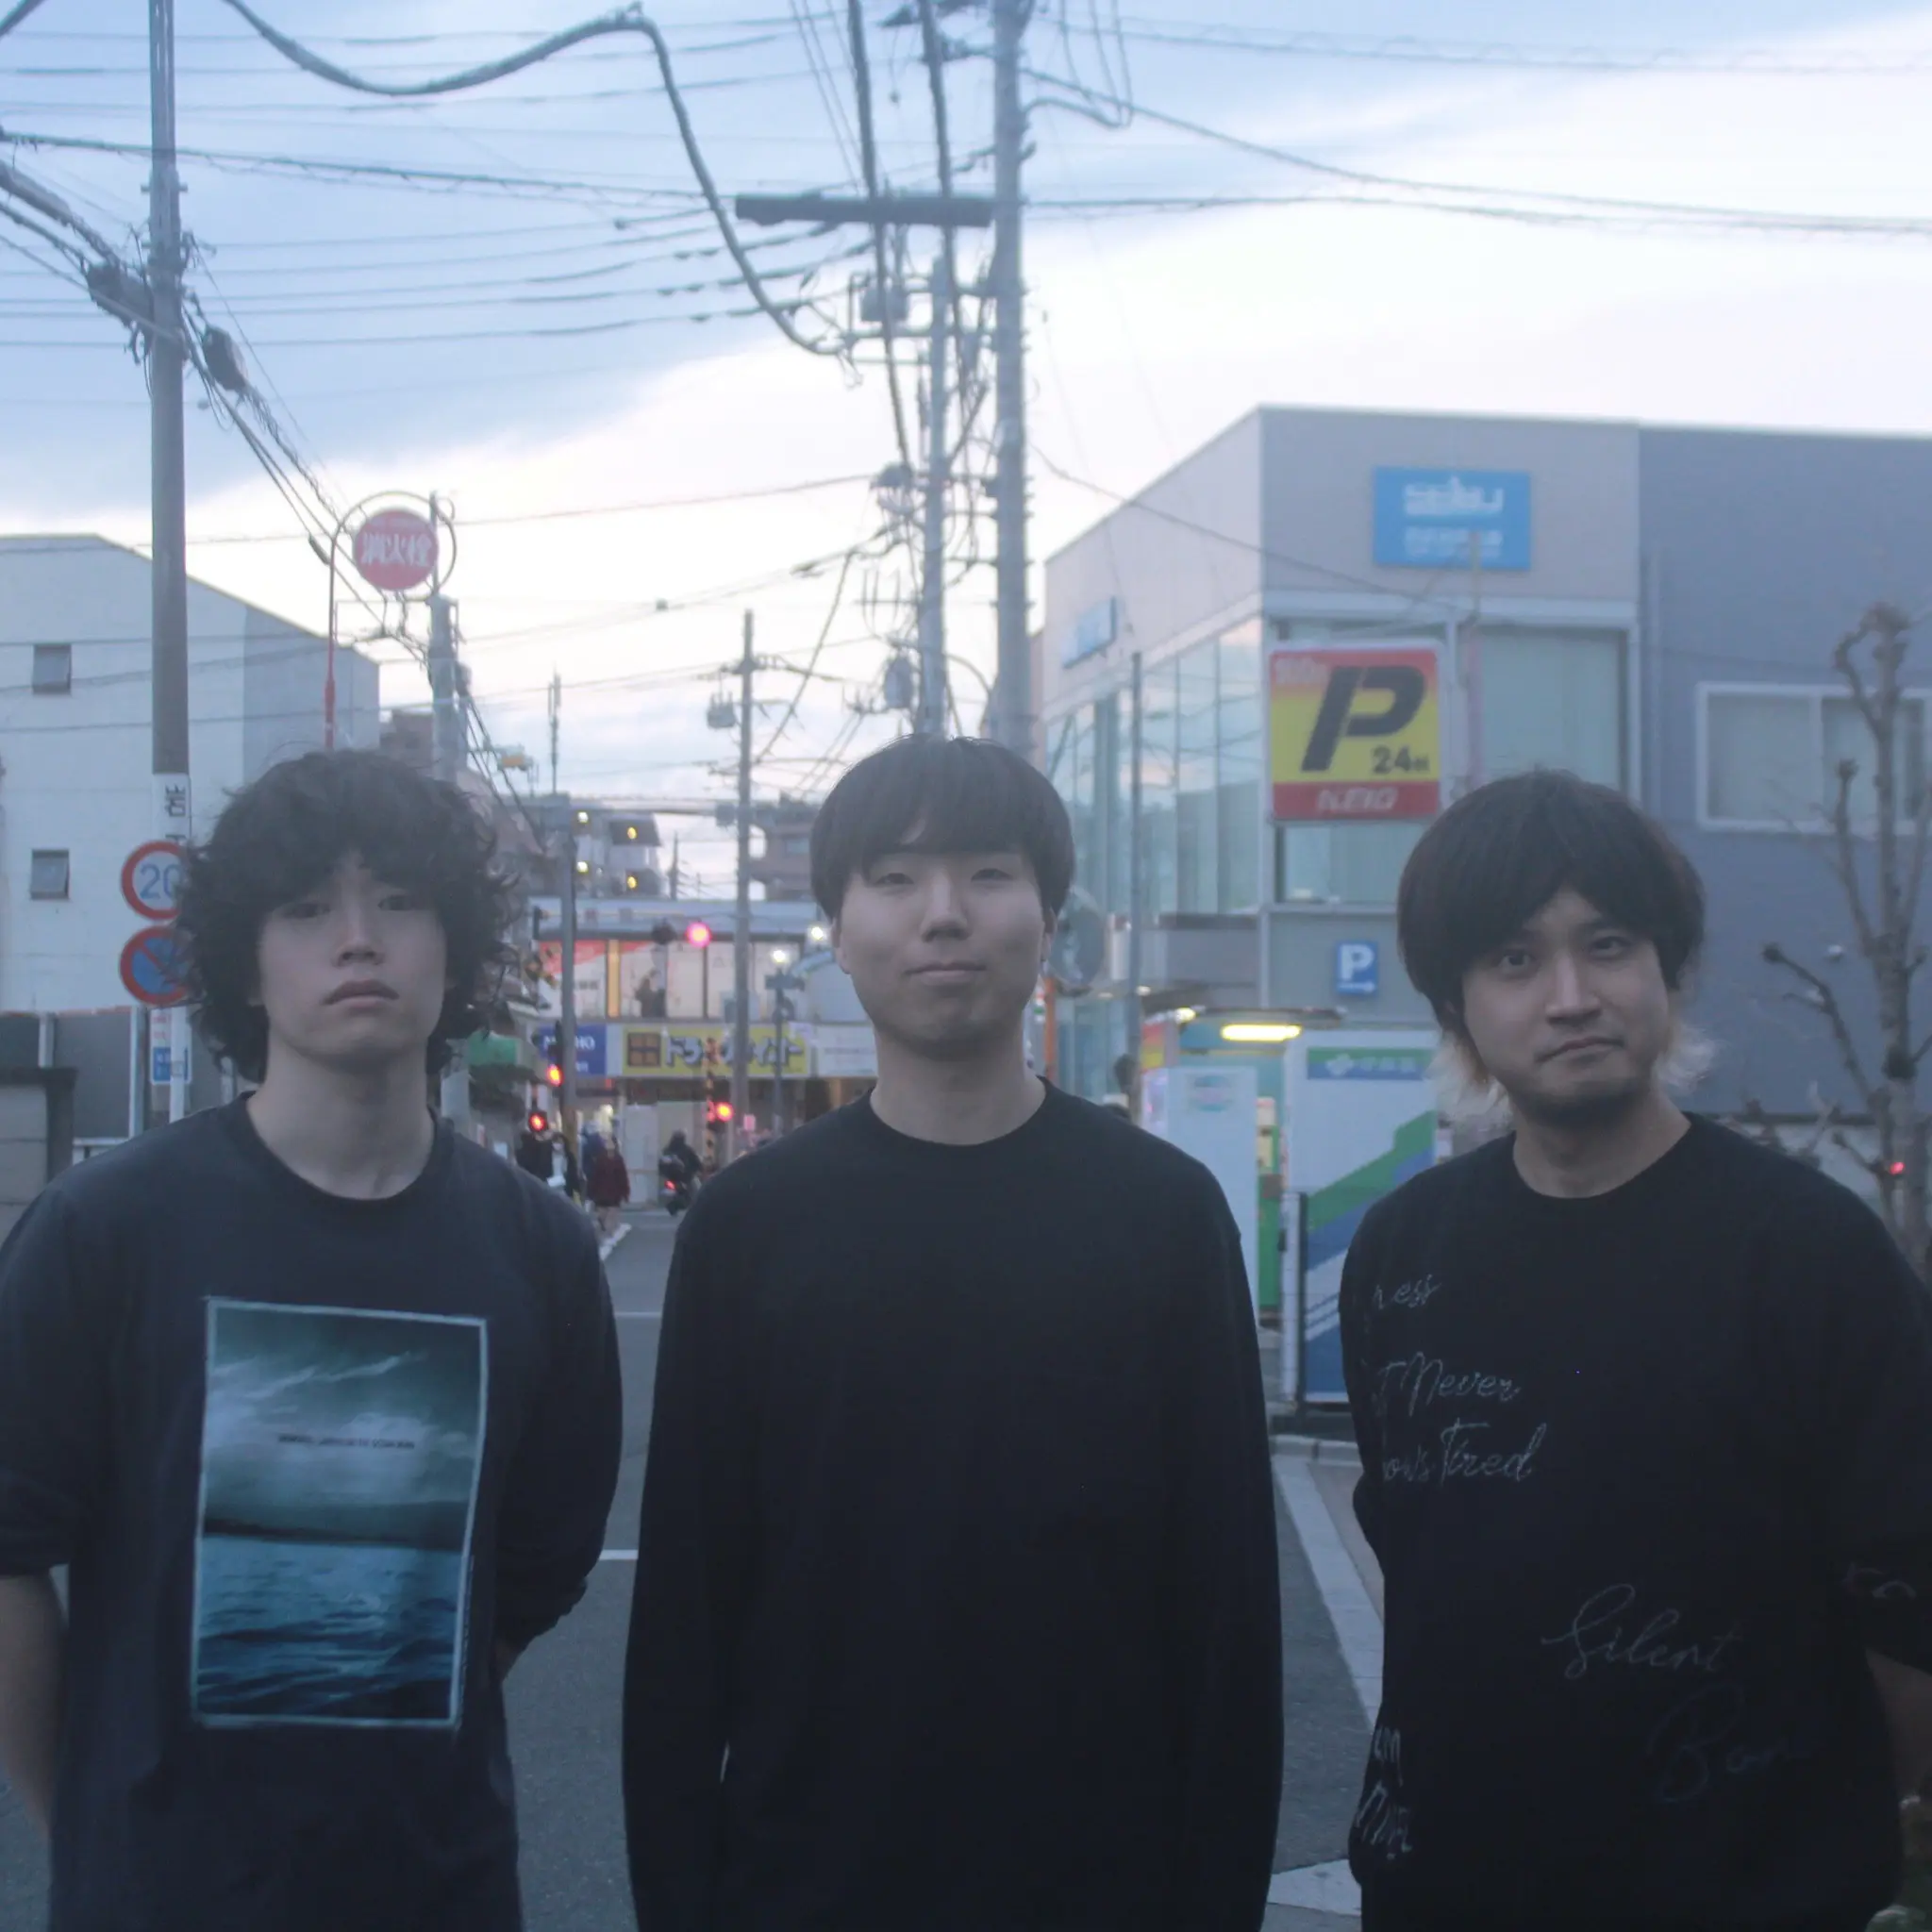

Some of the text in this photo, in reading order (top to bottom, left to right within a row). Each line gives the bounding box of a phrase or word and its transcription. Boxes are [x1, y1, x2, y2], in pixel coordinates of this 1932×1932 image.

[1300, 665, 1426, 774] P
[140, 863, 182, 900] 20
[1341, 944, 1375, 980] P
[1540, 1581, 1743, 1681] Silent
